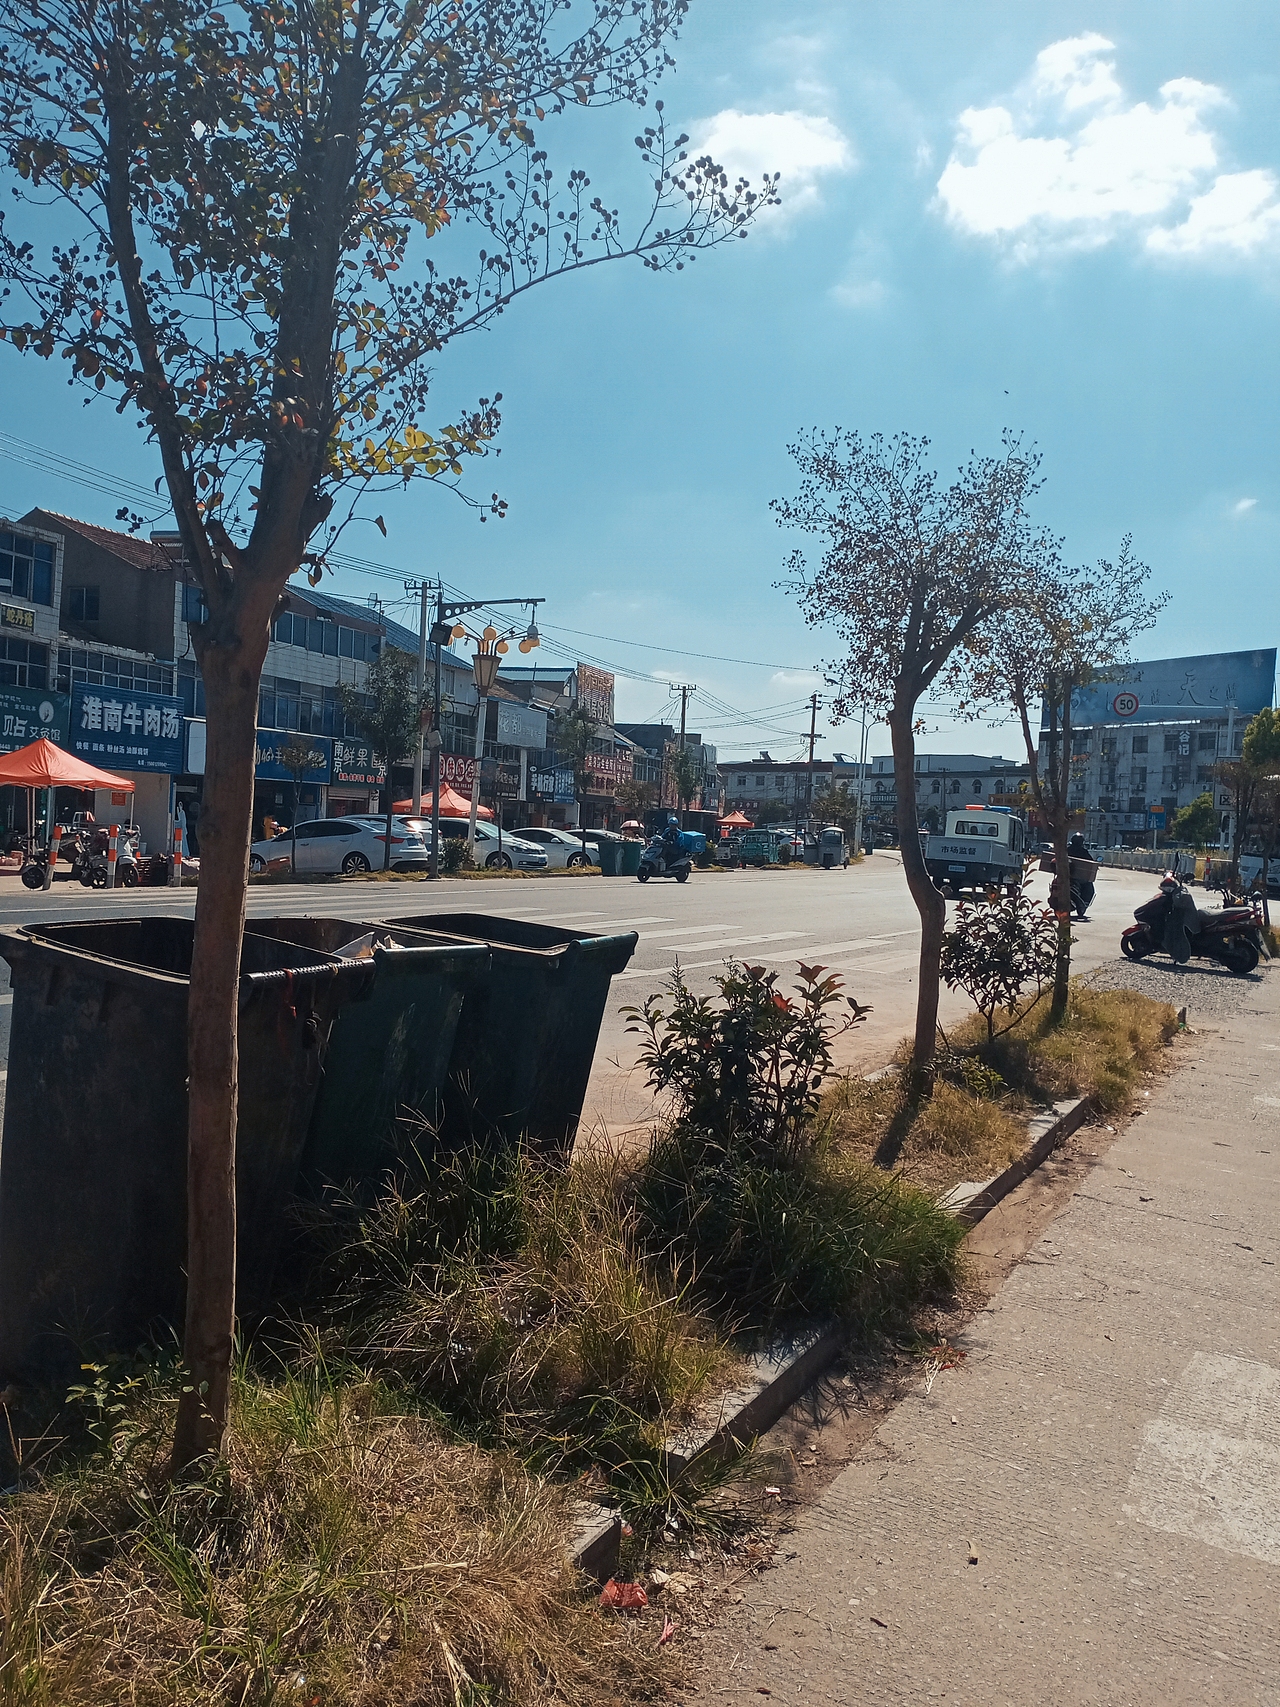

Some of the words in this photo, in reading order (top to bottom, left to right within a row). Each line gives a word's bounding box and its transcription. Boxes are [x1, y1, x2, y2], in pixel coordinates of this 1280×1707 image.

[80, 695, 180, 739] 淮南牛肉汤
[1119, 698, 1133, 710] 50
[2, 714, 28, 737] 贴
[29, 725, 61, 741] 艾灸馆
[1178, 730, 1191, 756] 谷记
[333, 740, 344, 773] 南京
[941, 845, 977, 856] 市场监督
